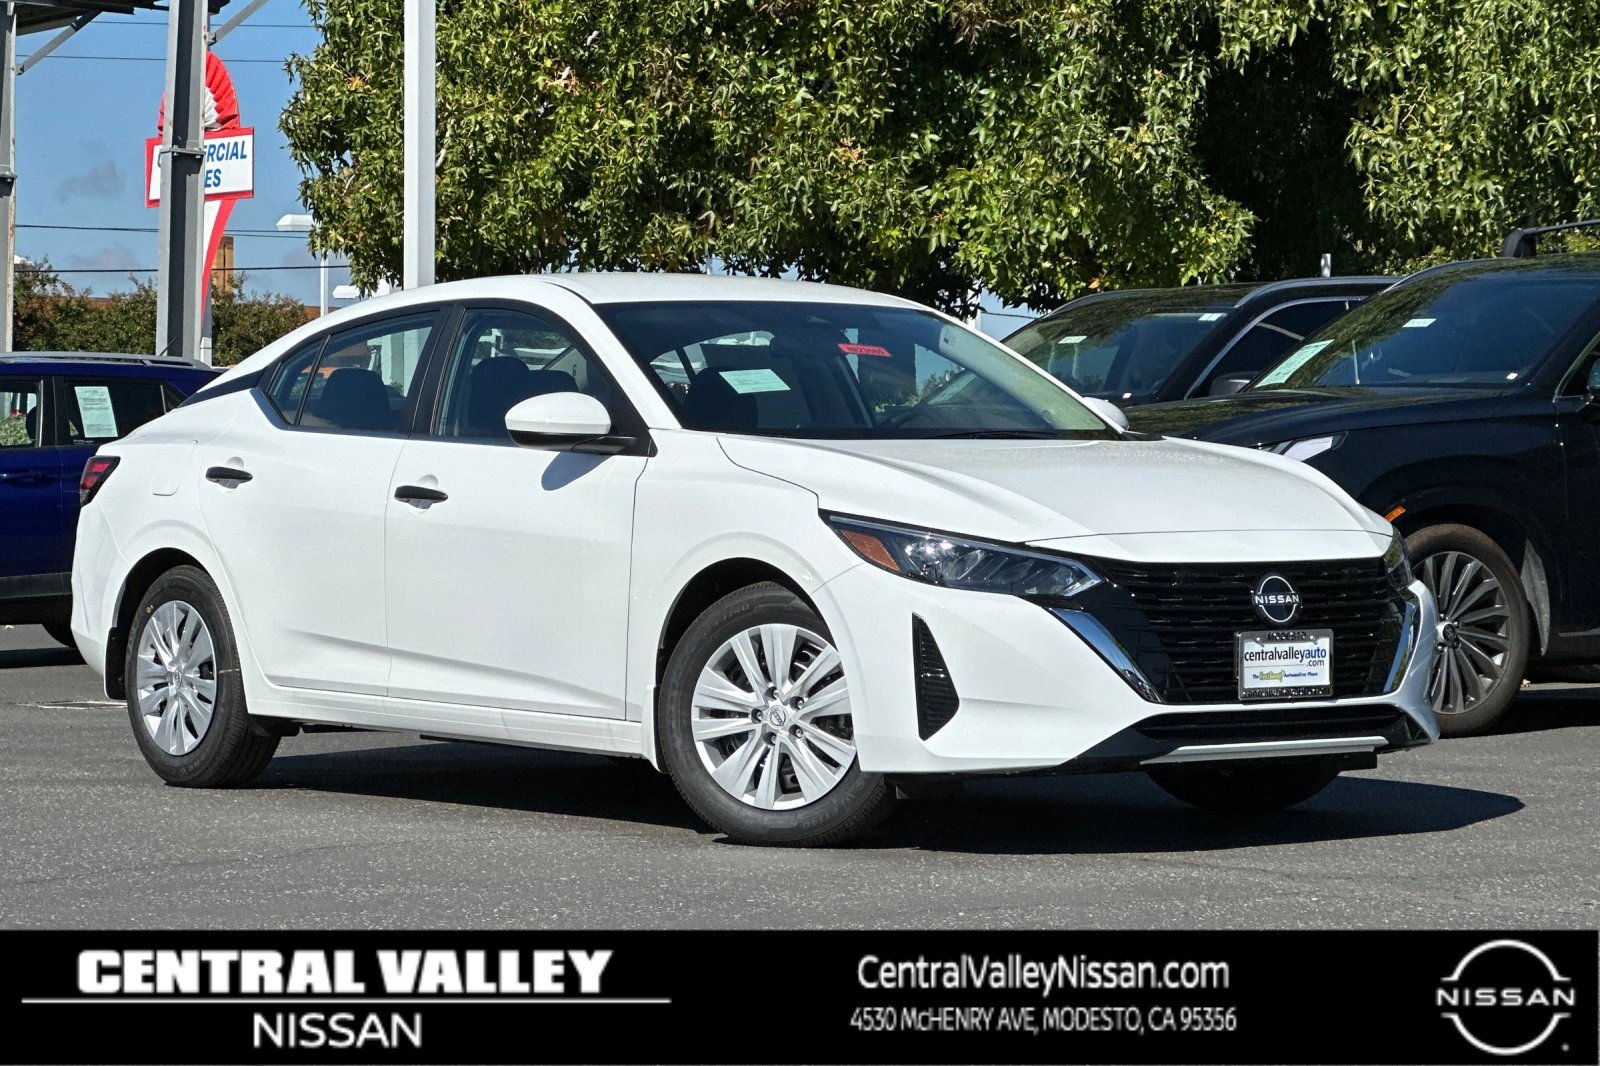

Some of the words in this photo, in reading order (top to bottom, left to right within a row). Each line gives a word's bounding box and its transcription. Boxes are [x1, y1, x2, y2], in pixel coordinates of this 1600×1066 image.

[1255, 594, 1299, 604] NISSAN
[1244, 647, 1327, 663] centralvalleyauto
[1306, 659, 1325, 667] .com
